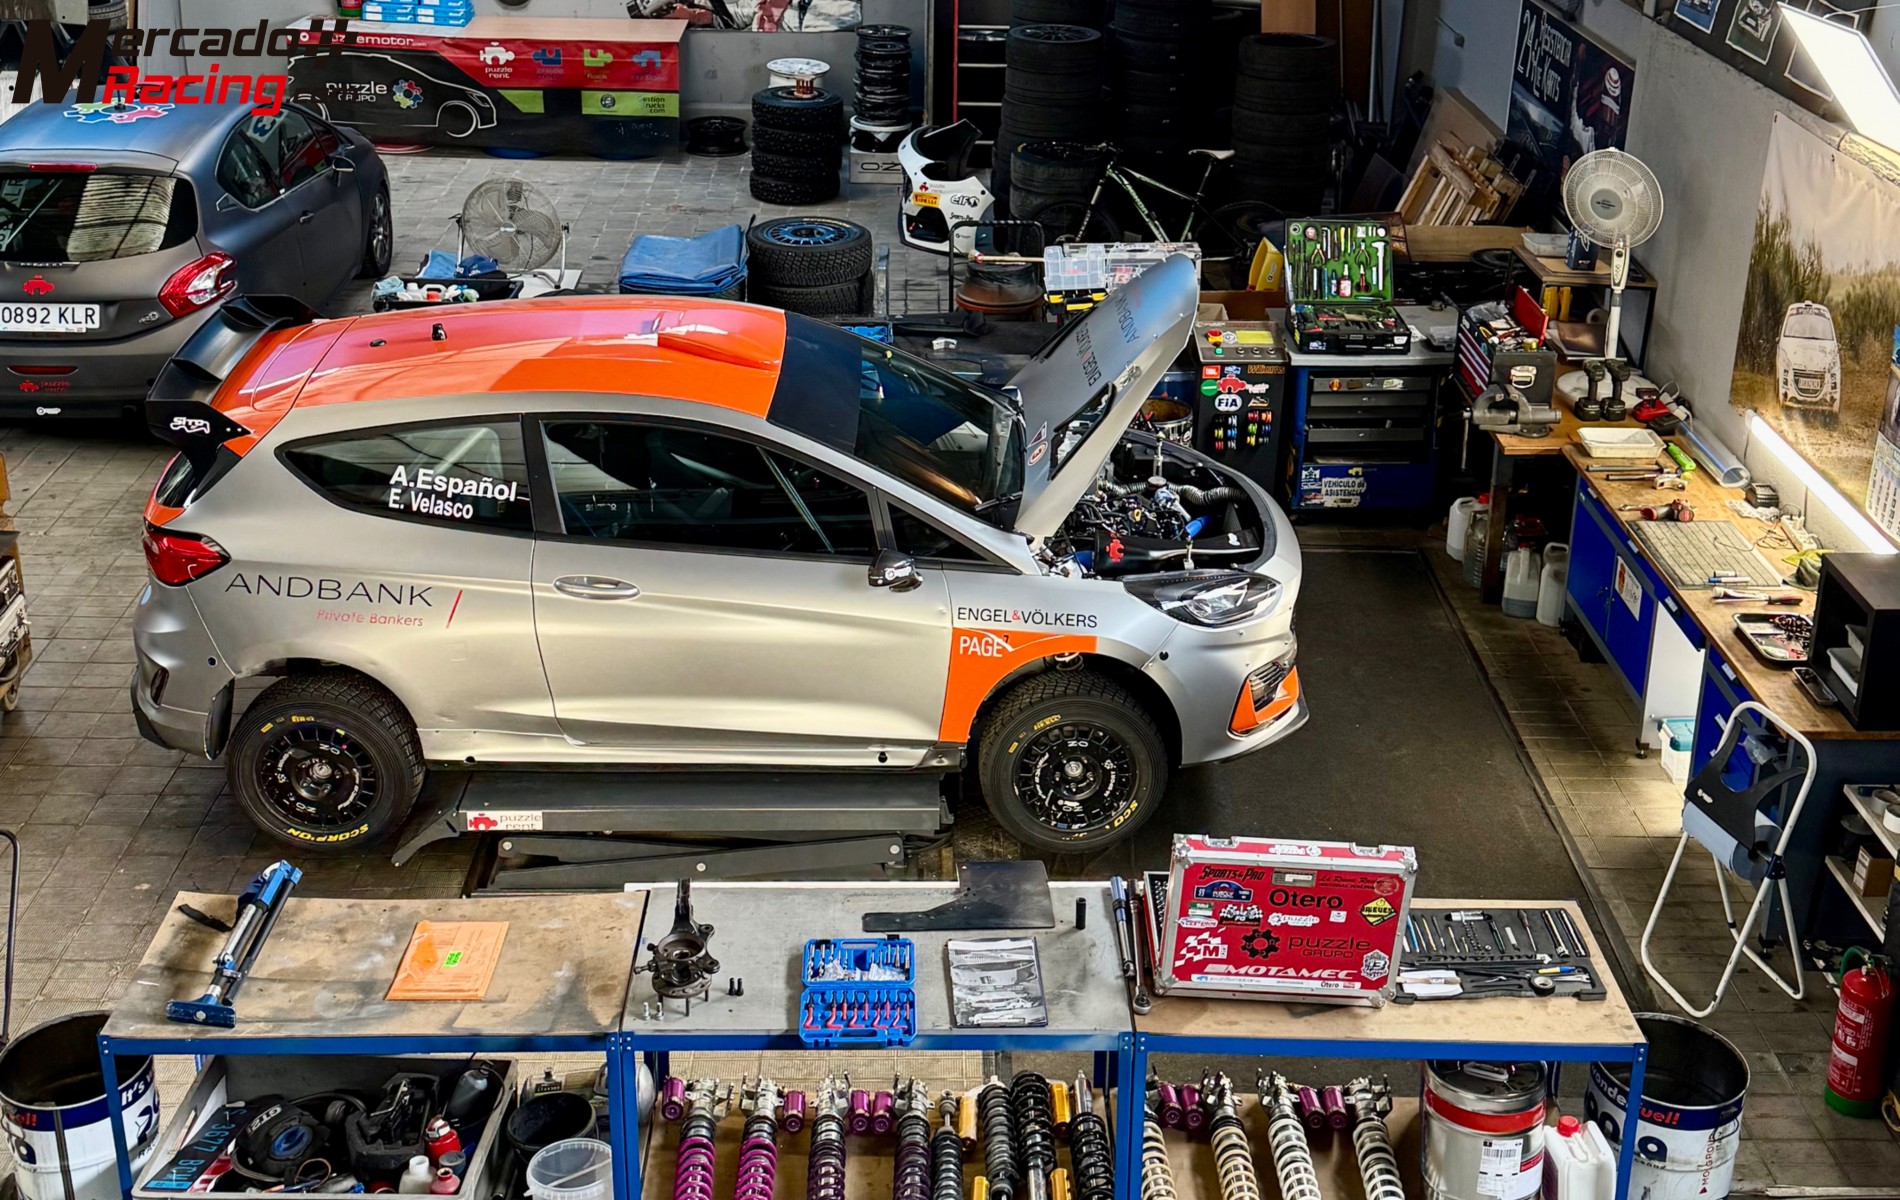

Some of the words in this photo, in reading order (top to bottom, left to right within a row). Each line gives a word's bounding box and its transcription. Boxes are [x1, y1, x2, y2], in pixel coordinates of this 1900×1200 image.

[1, 306, 51, 325] 0892
[58, 306, 96, 326] KLR
[1217, 398, 1239, 408] FIA
[389, 489, 405, 509] E.
[411, 491, 474, 520] Velasco
[225, 573, 433, 608] ANDBANK
[316, 609, 365, 624] Private
[369, 613, 424, 627] Bankers
[957, 607, 1099, 628] ENGEL&VÖLKERS
[500, 813, 542, 823] puzzle
[1269, 888, 1343, 909] Otero
[1288, 936, 1371, 951] puzzle
[1302, 948, 1354, 959] GRUPO
[1224, 963, 1358, 980] MOTAMEC
